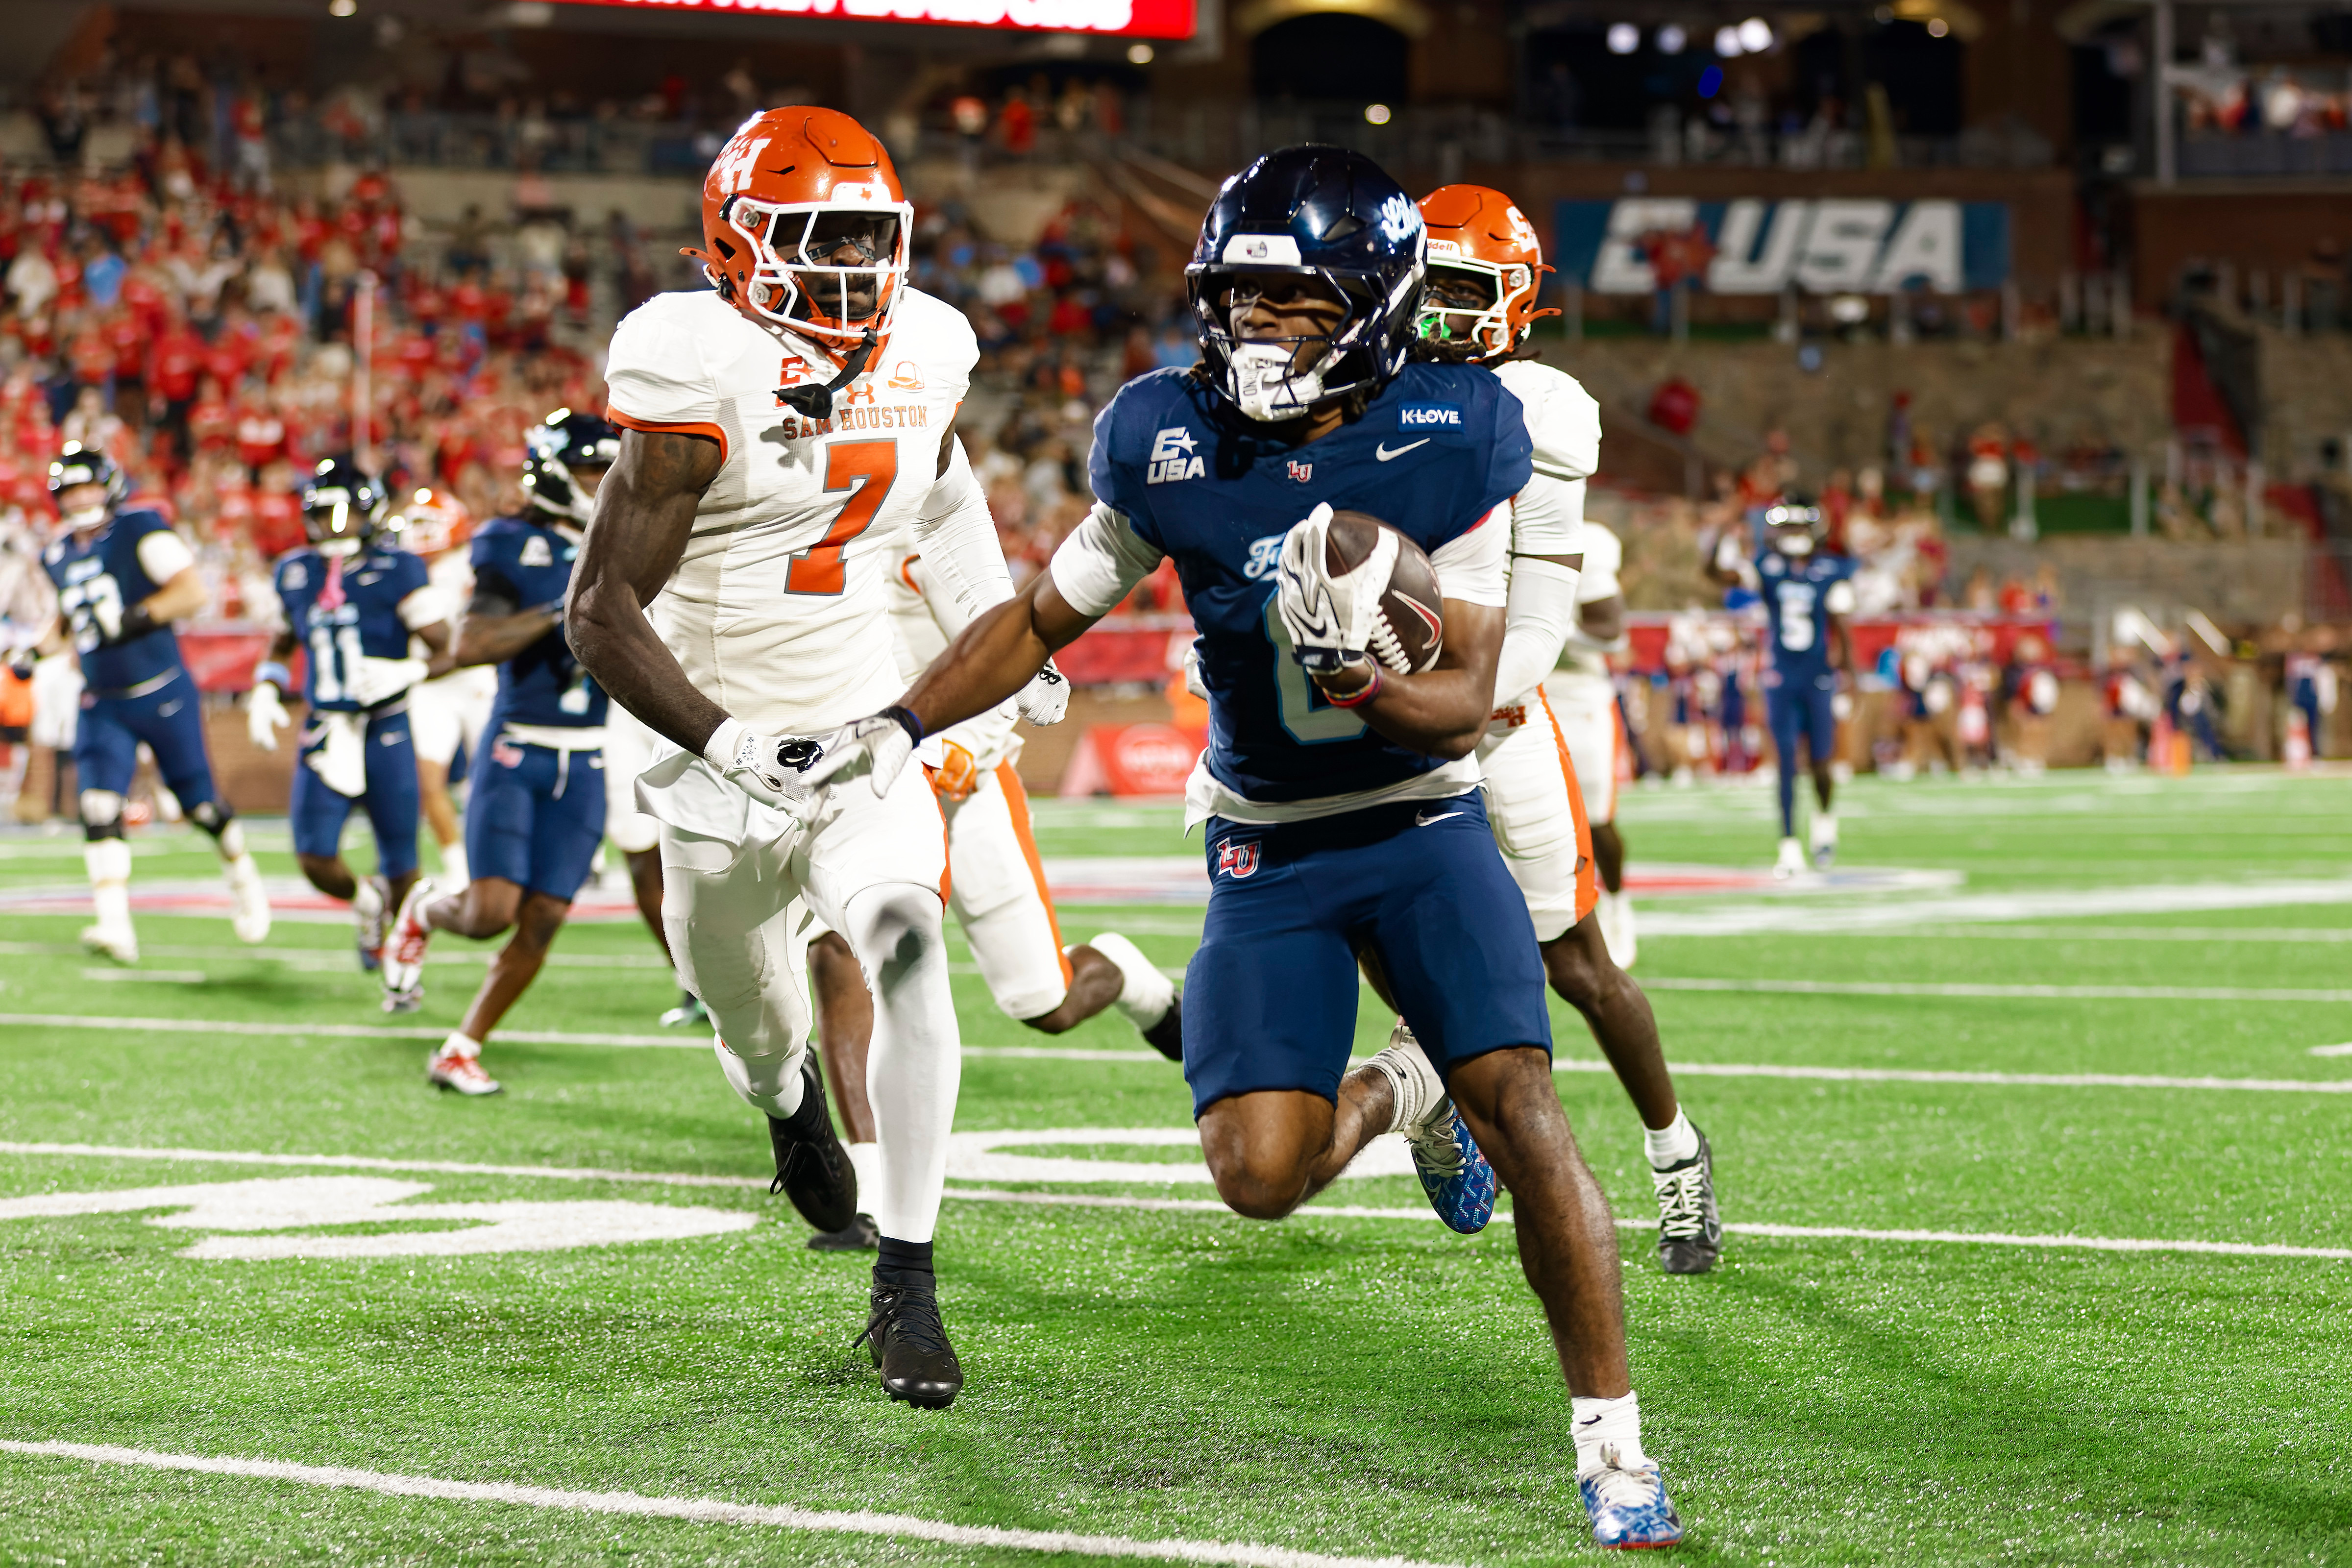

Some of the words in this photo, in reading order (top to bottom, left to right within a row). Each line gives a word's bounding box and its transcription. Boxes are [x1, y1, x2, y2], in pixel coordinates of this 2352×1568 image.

[784, 416, 833, 440] SAM
[839, 406, 927, 431] HOUSTON
[1147, 456, 1205, 485] USA
[1286, 460, 1313, 484] LU
[784, 438, 898, 595] 7
[1780, 599, 1815, 652] 5
[1216, 836, 1262, 879] LU
